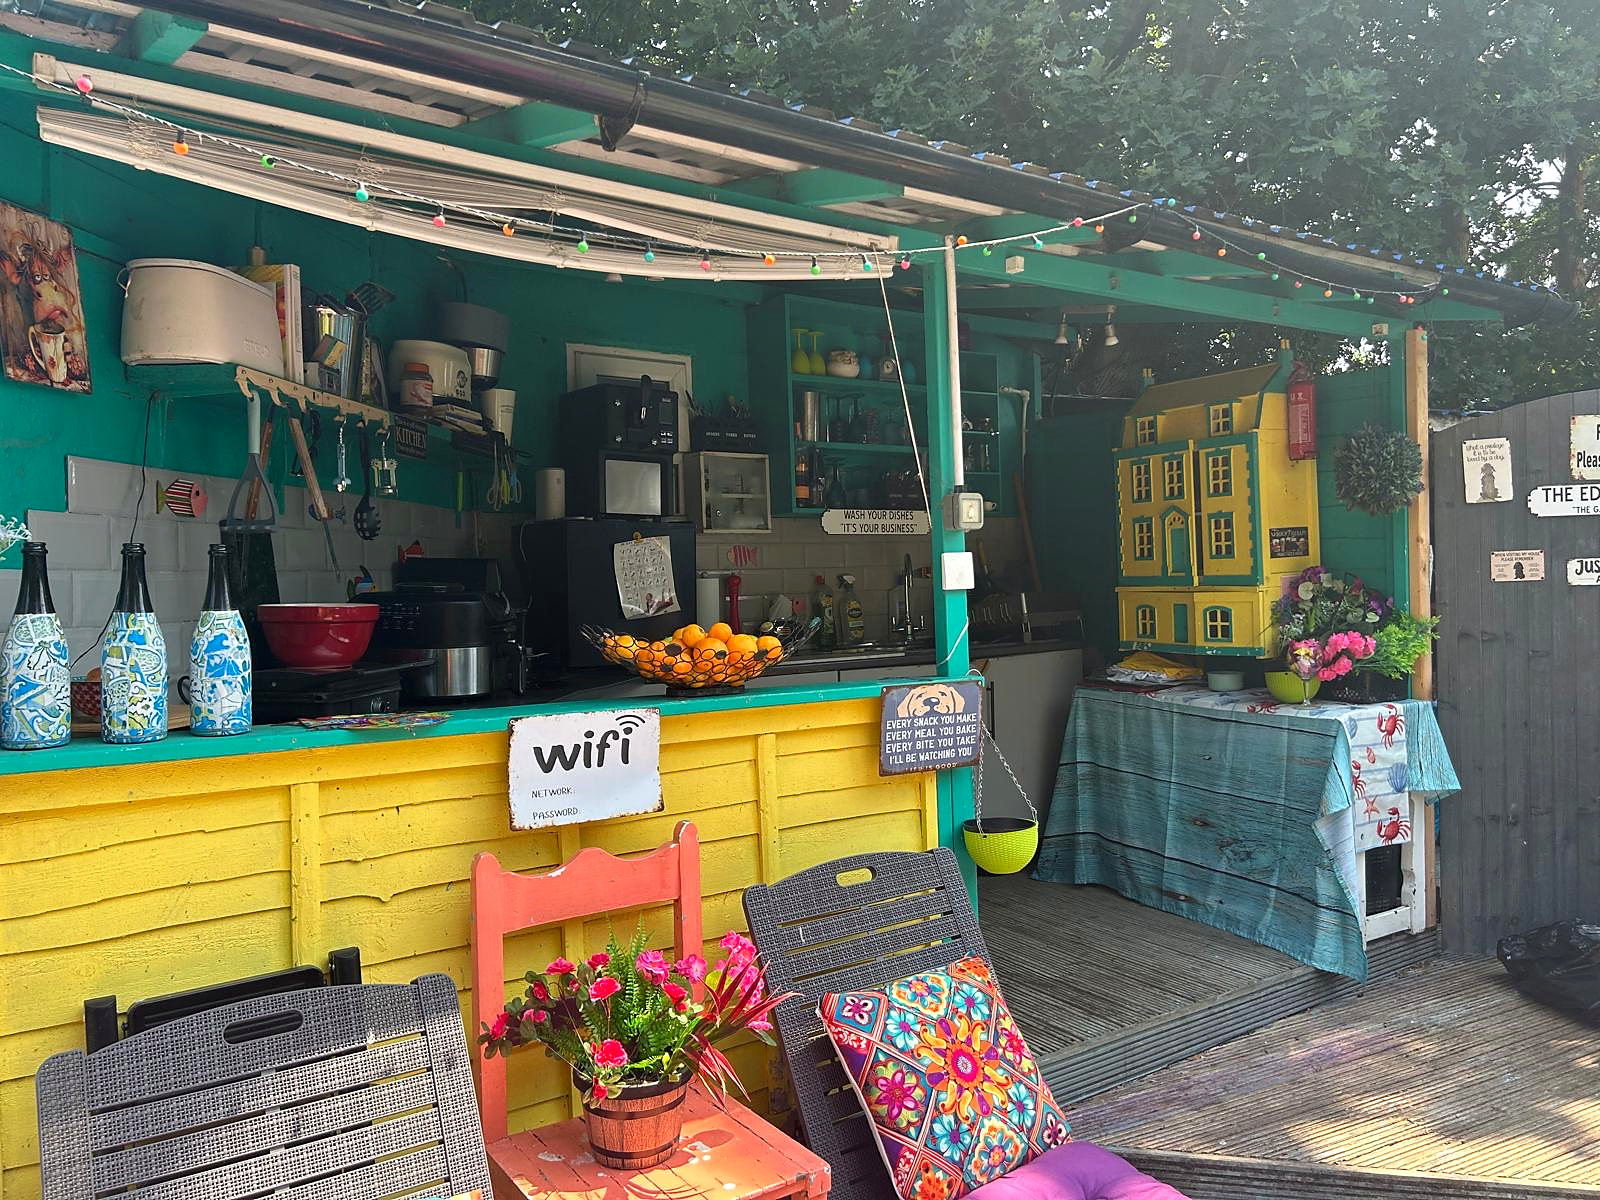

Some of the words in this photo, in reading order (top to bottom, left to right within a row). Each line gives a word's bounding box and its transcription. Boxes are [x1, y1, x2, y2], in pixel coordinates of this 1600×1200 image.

[396, 426, 426, 449] KITCHEN
[1542, 487, 1573, 502] THE
[1580, 486, 1600, 501] ED
[843, 510, 865, 520] WASH
[868, 510, 887, 520] YOUR
[889, 510, 914, 520] DISHES
[860, 523, 879, 533] YOUR
[886, 719, 913, 730] EVERY
[914, 716, 938, 727] SNACK
[940, 715, 955, 725] YOU
[956, 713, 977, 722] MAKE
[886, 730, 912, 741] EVERY
[915, 728, 936, 738] MEAL
[940, 726, 954, 736] YOU
[956, 724, 977, 734] BAKE
[533, 727, 633, 774] wifi
[886, 742, 912, 753] EVERY
[916, 740, 934, 749] BITE
[938, 738, 953, 747] YOU
[956, 735, 976, 745] TAKE
[889, 755, 904, 765] I'LL
[906, 753, 917, 762] BE
[919, 749, 955, 761] WATCHING
[958, 746, 972, 756] YOU
